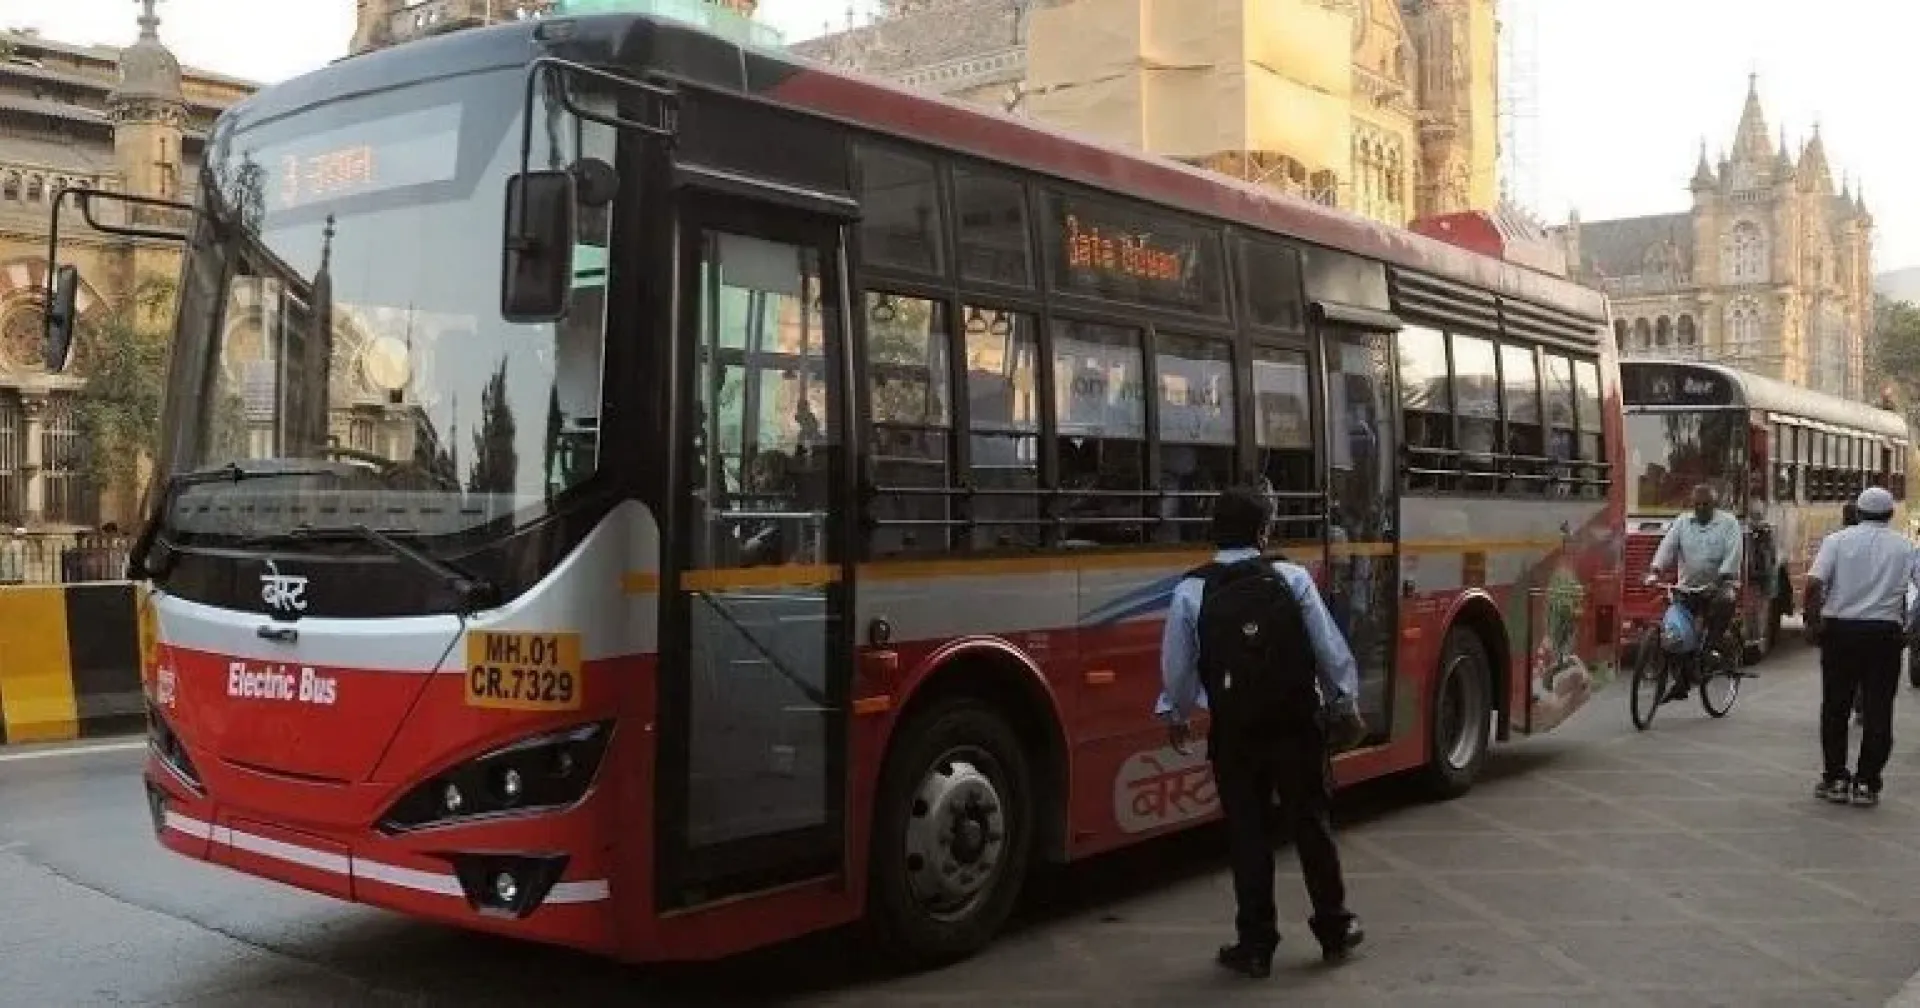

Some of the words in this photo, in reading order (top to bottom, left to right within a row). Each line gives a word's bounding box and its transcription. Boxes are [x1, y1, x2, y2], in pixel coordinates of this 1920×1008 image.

[260, 560, 308, 611] बेस्ट
[486, 634, 558, 665] MH.01
[228, 662, 296, 700] Electric
[300, 667, 337, 704] Bus
[471, 665, 573, 703] CR.7329
